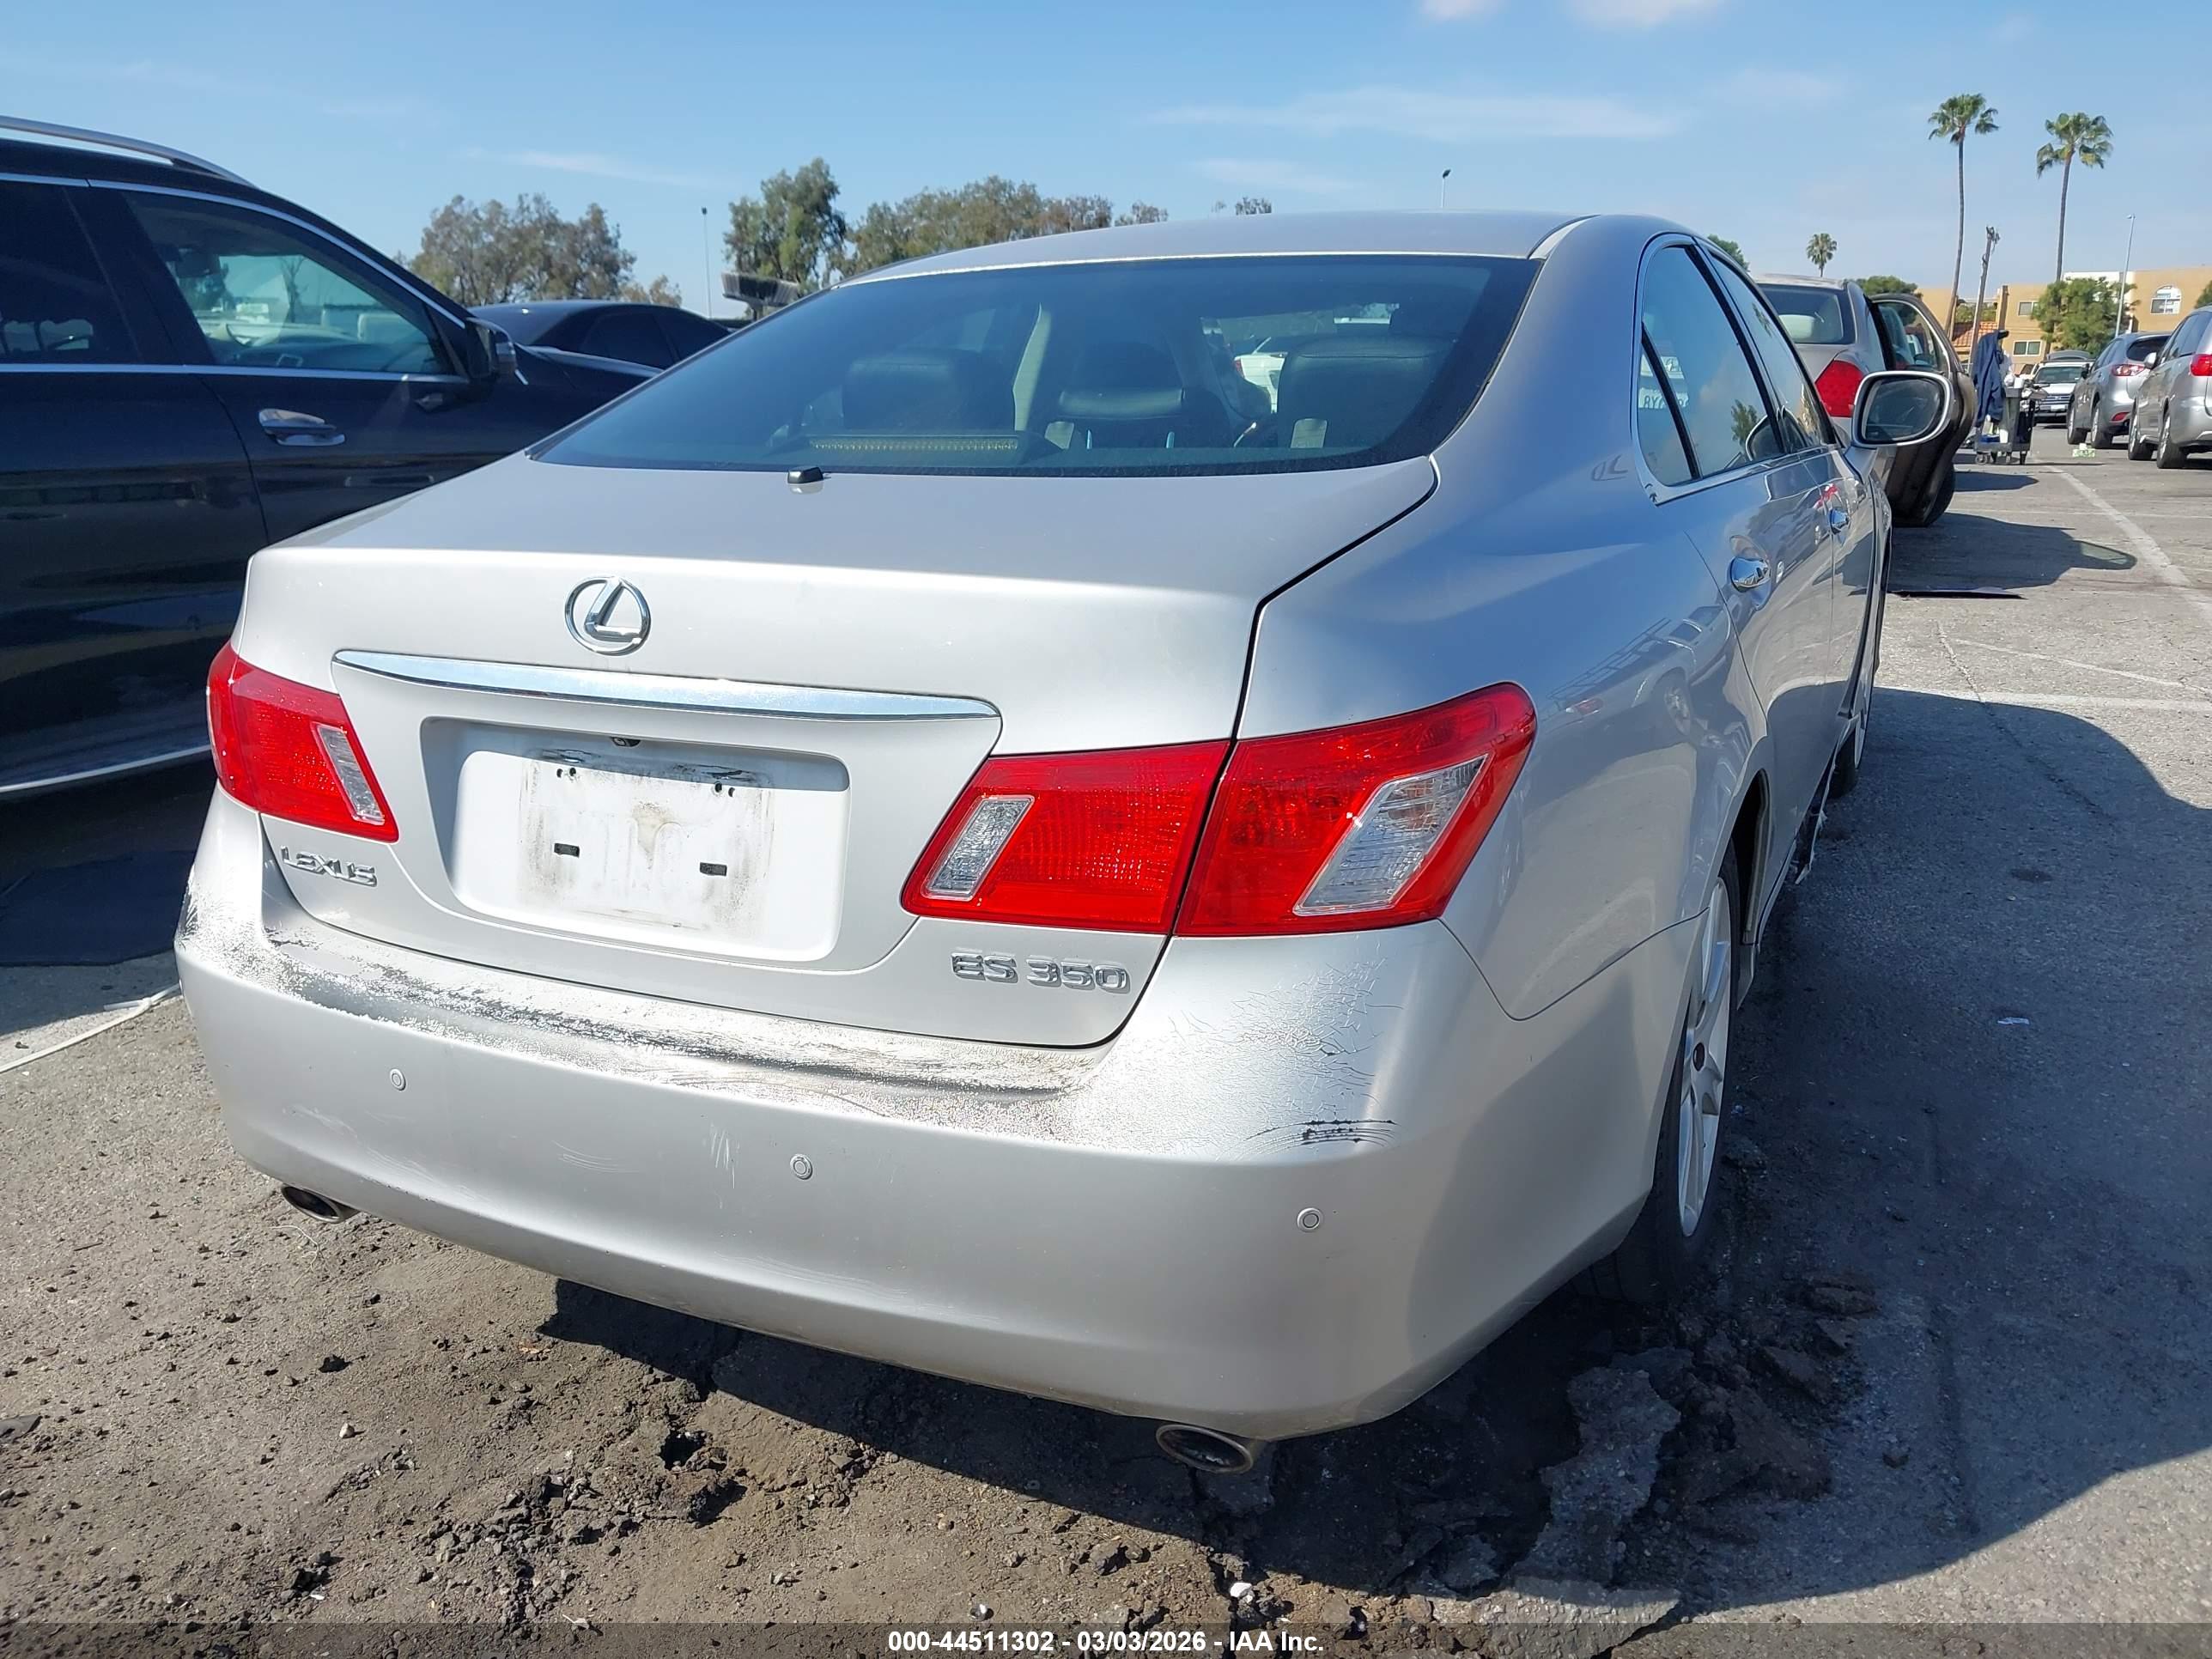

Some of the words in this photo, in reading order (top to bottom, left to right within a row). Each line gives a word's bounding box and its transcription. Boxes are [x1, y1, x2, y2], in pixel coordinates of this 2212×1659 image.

[280, 846, 378, 889] LEXUS
[951, 950, 1018, 982] ES
[1026, 956, 1131, 992] 350
